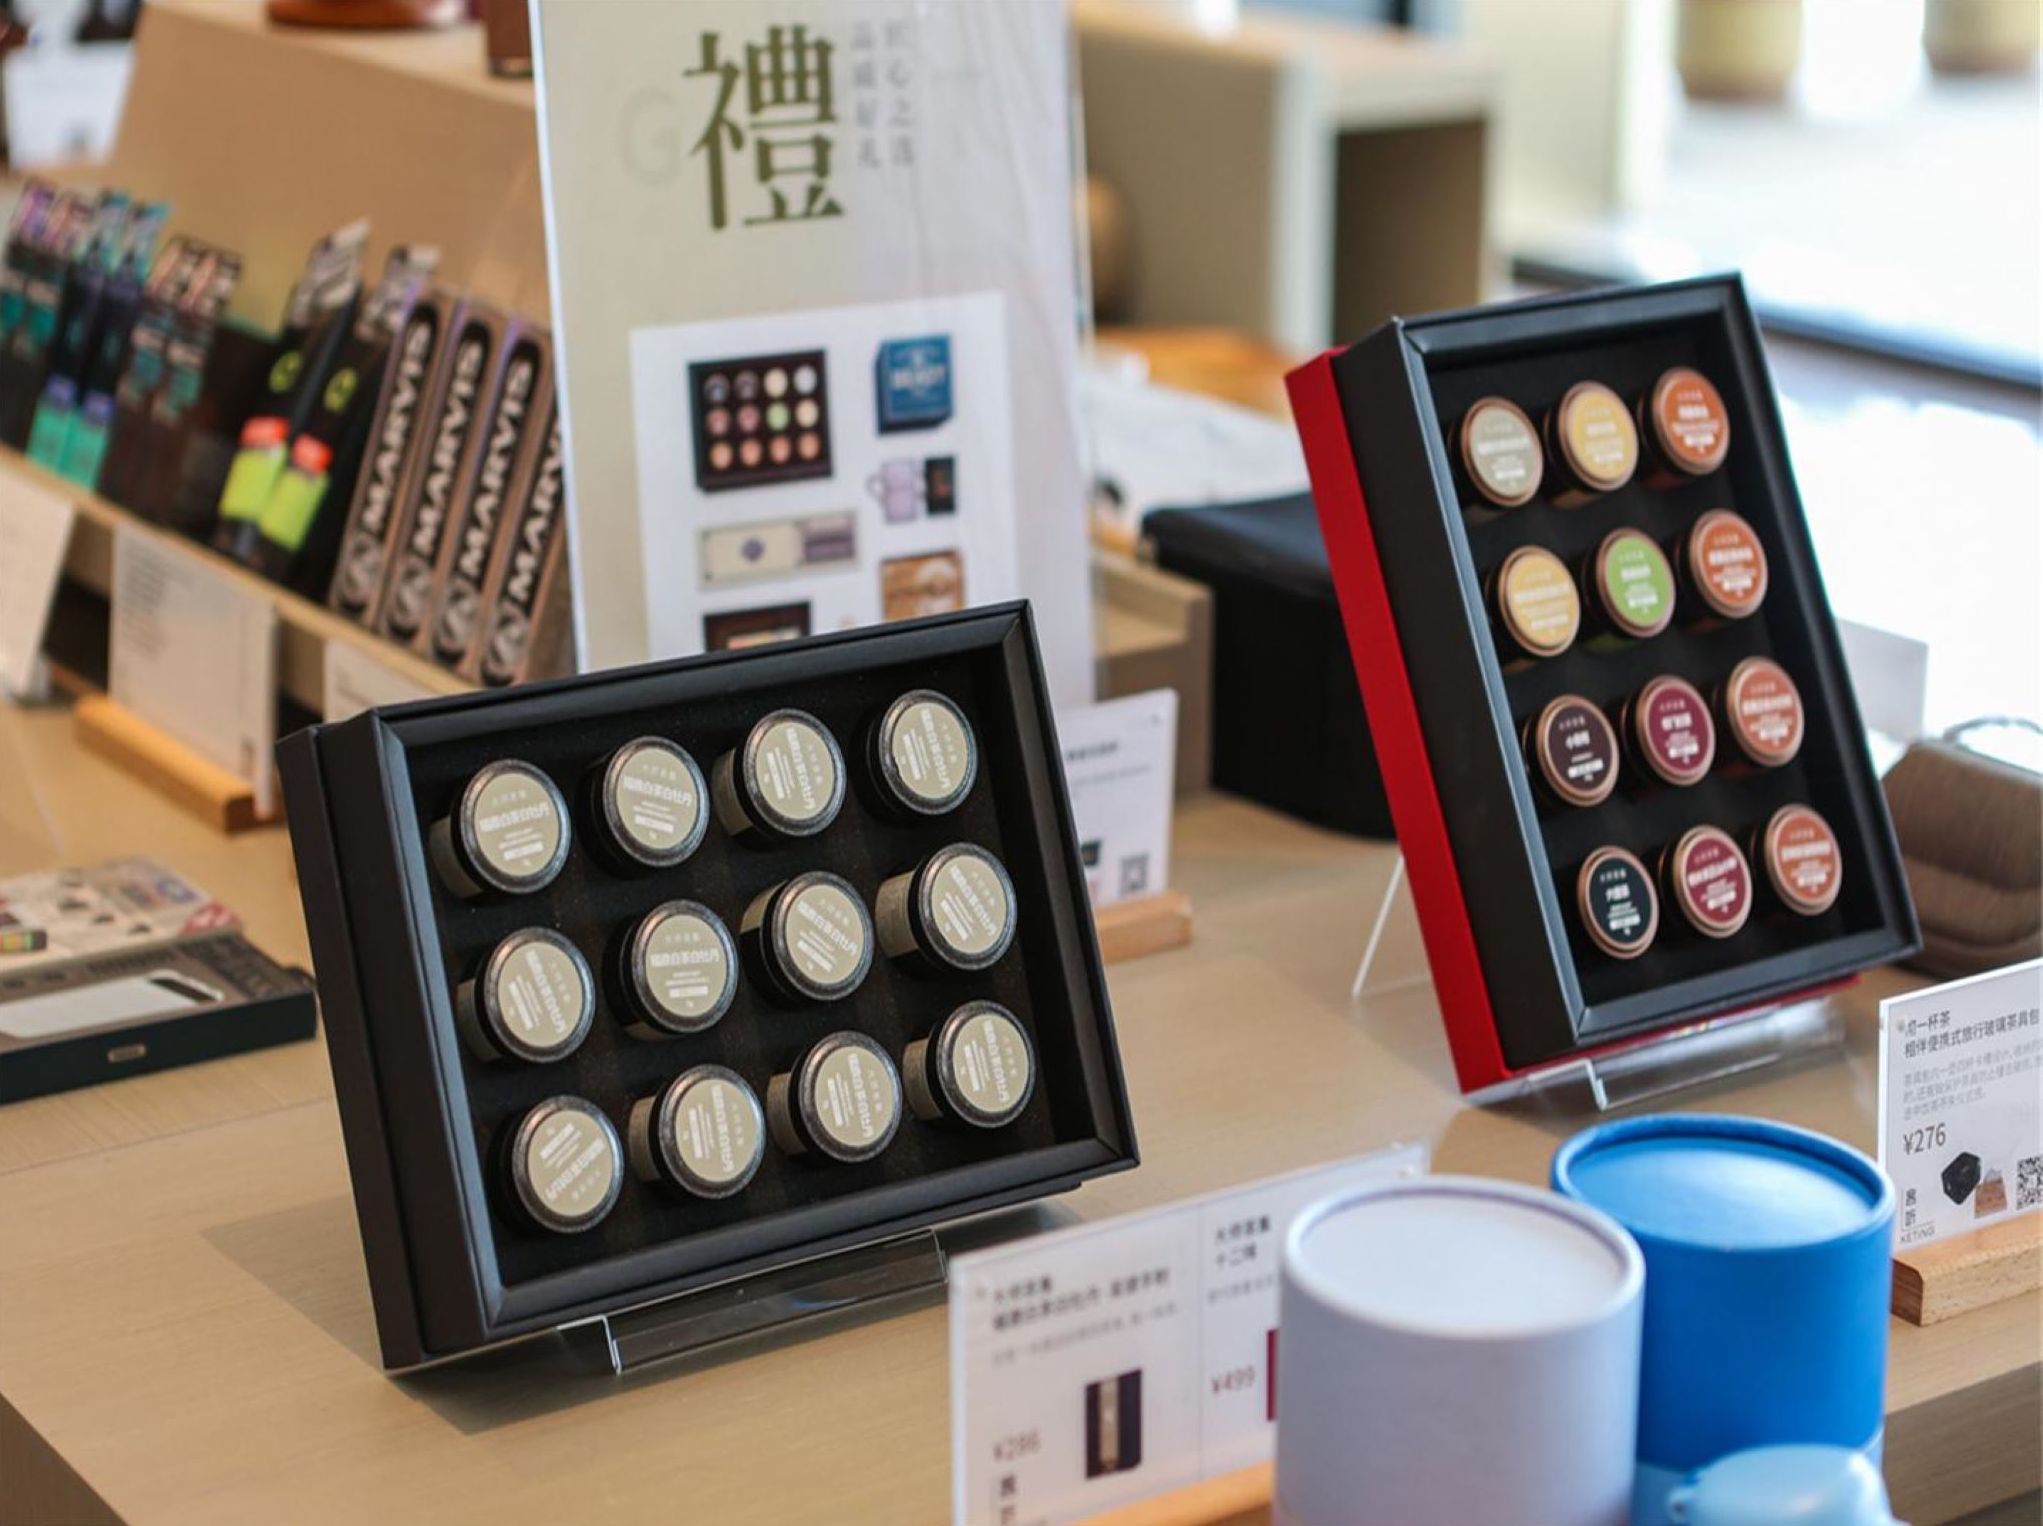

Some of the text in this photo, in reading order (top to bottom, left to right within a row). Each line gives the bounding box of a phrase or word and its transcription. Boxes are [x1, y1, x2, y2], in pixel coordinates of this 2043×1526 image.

[683, 24, 844, 232] 禮
[362, 319, 431, 533] MARVIS
[413, 338, 484, 555] MARVIS
[460, 358, 533, 575] MARVIS
[1903, 1122, 1946, 1155] ¥276
